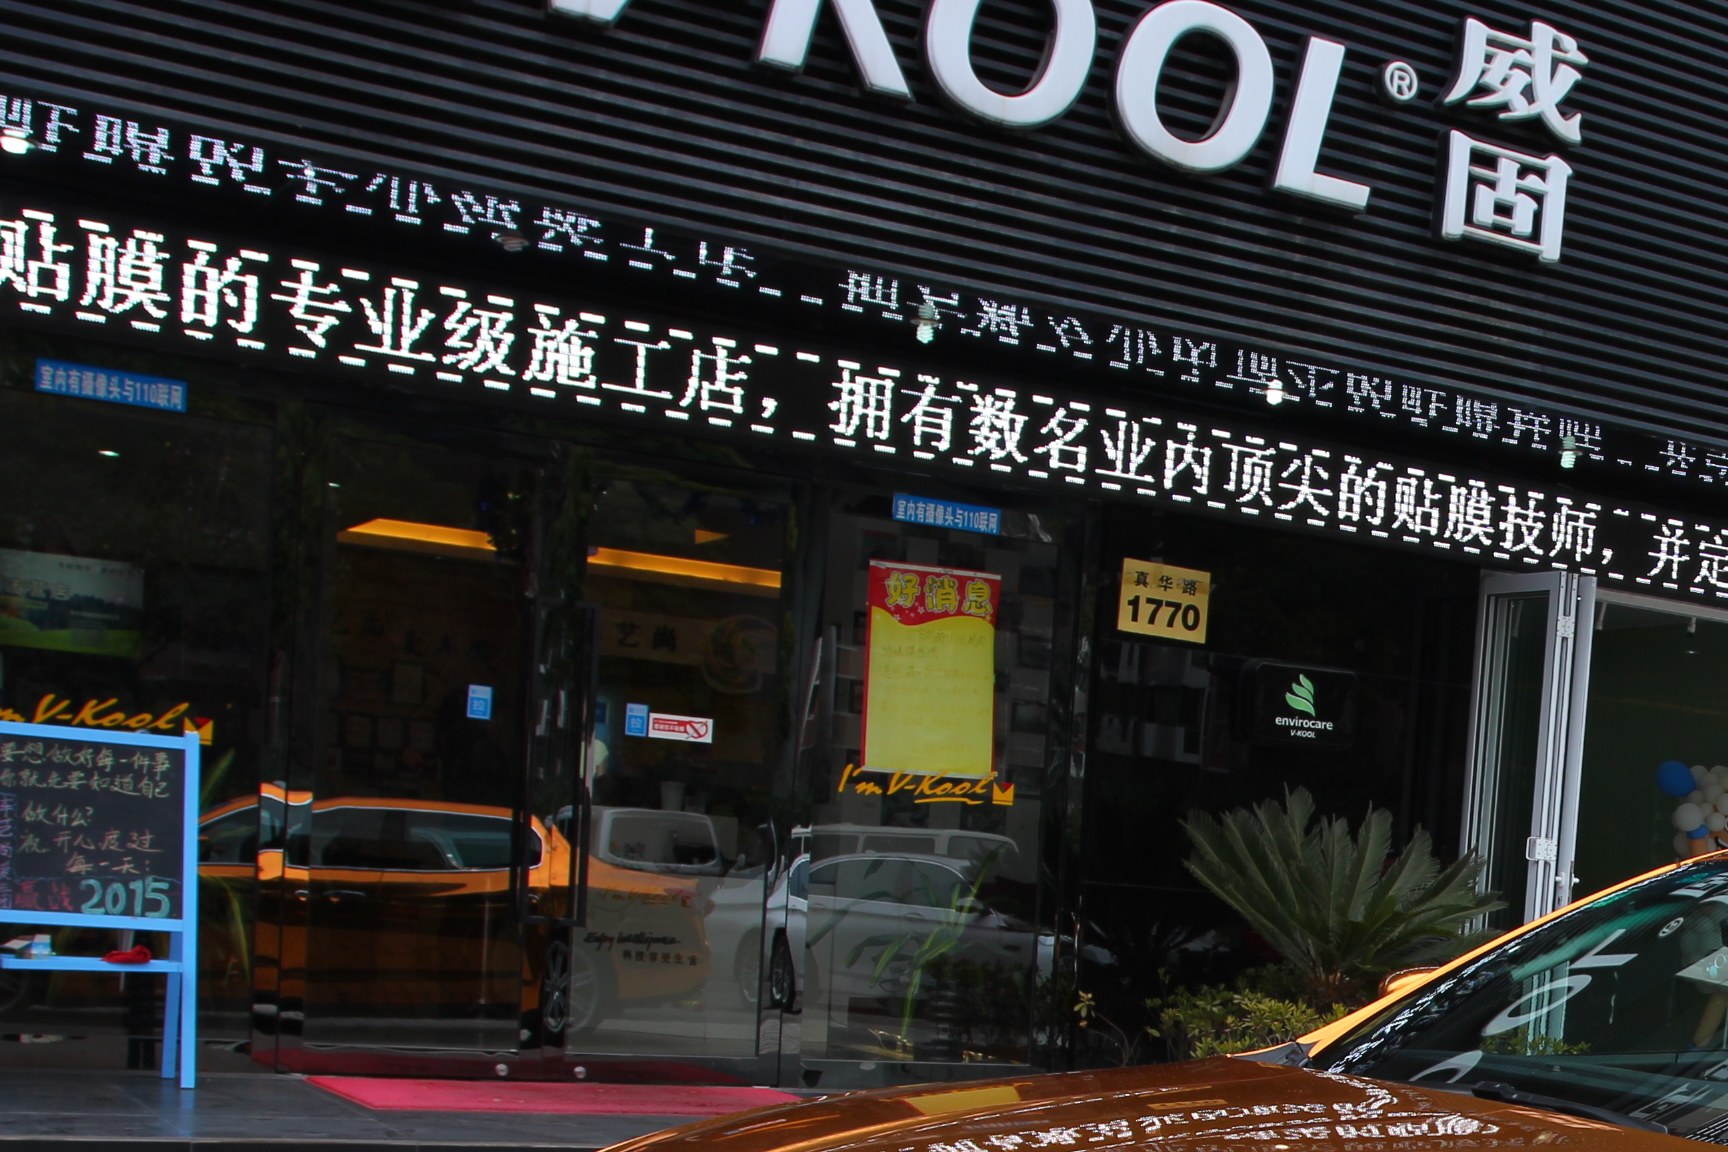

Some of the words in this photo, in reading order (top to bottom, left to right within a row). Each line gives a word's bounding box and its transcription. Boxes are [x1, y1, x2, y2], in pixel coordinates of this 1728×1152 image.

[1440, 17, 1588, 264] 威固
[39, 363, 184, 410] 室内有摄像头与110联网
[895, 498, 999, 535] 室内有摄像头与110联网
[884, 571, 994, 616] 好消息
[1133, 570, 1198, 596] 真华路
[1127, 595, 1201, 631] 1770
[1275, 716, 1334, 730] envirocare
[1290, 729, 1317, 739] V-KOOL
[79, 875, 172, 919] 2015
